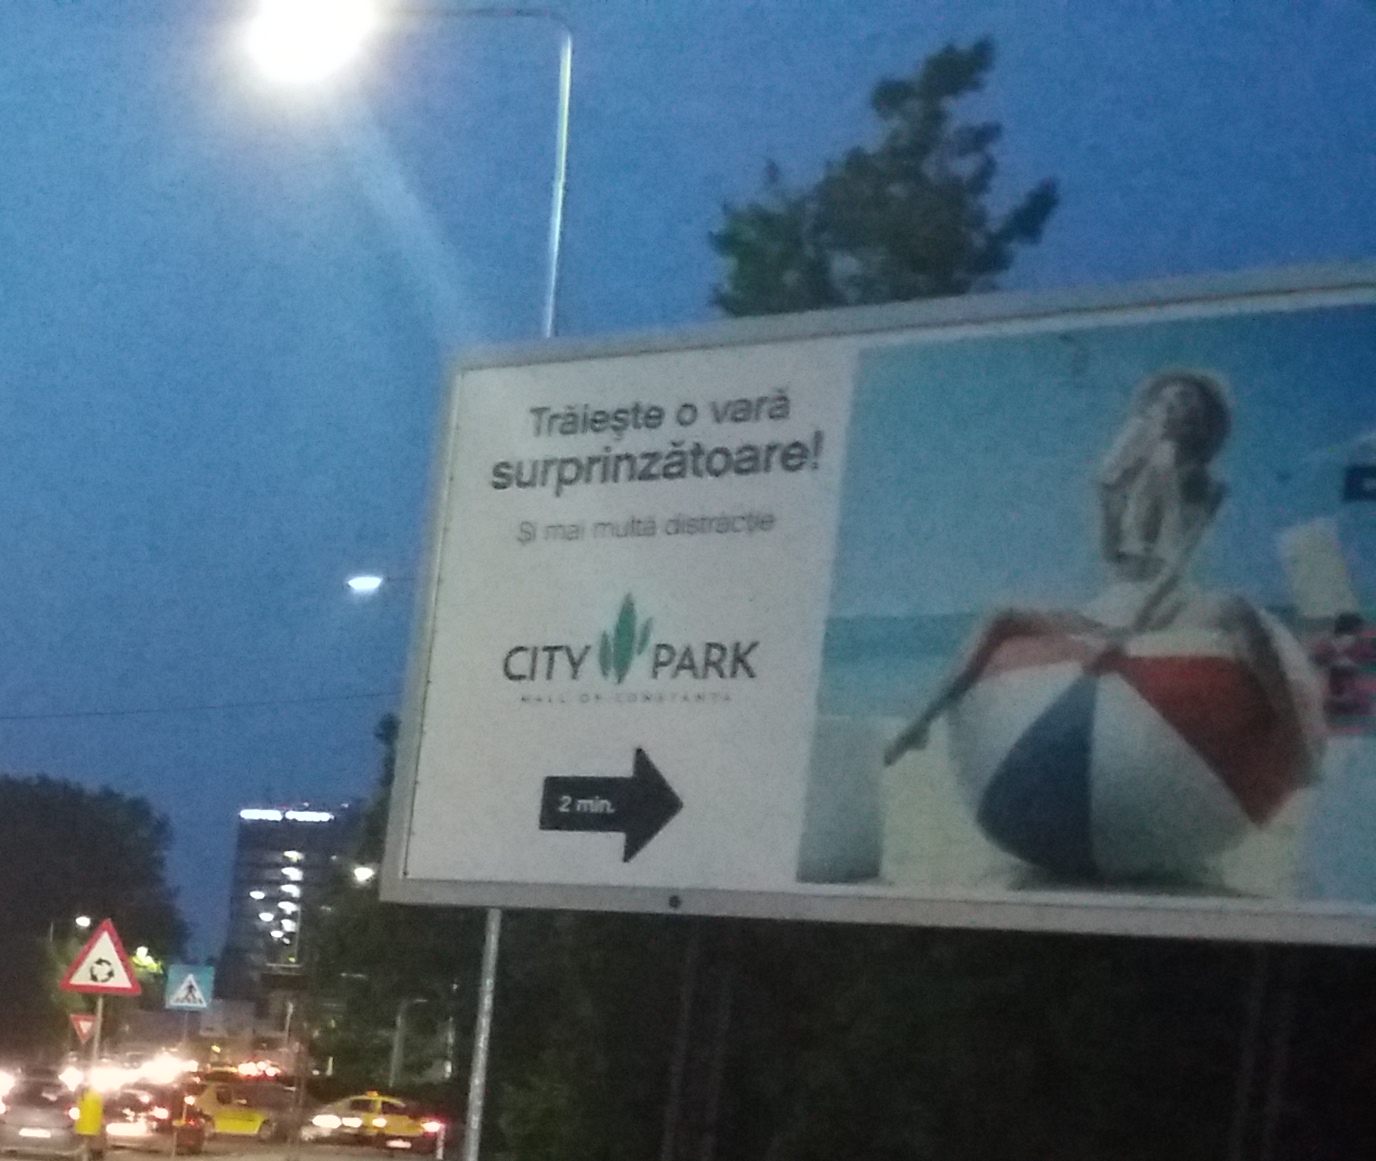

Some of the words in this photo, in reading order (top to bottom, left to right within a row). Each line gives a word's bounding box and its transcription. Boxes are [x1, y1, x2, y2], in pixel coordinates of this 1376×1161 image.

[677, 403, 698, 428] o
[711, 387, 791, 424] vară
[491, 431, 825, 498] surprinzătoare!
[546, 521, 585, 542] mai
[502, 644, 592, 682] CITY
[650, 641, 761, 679] PARK
[558, 795, 571, 813] 2
